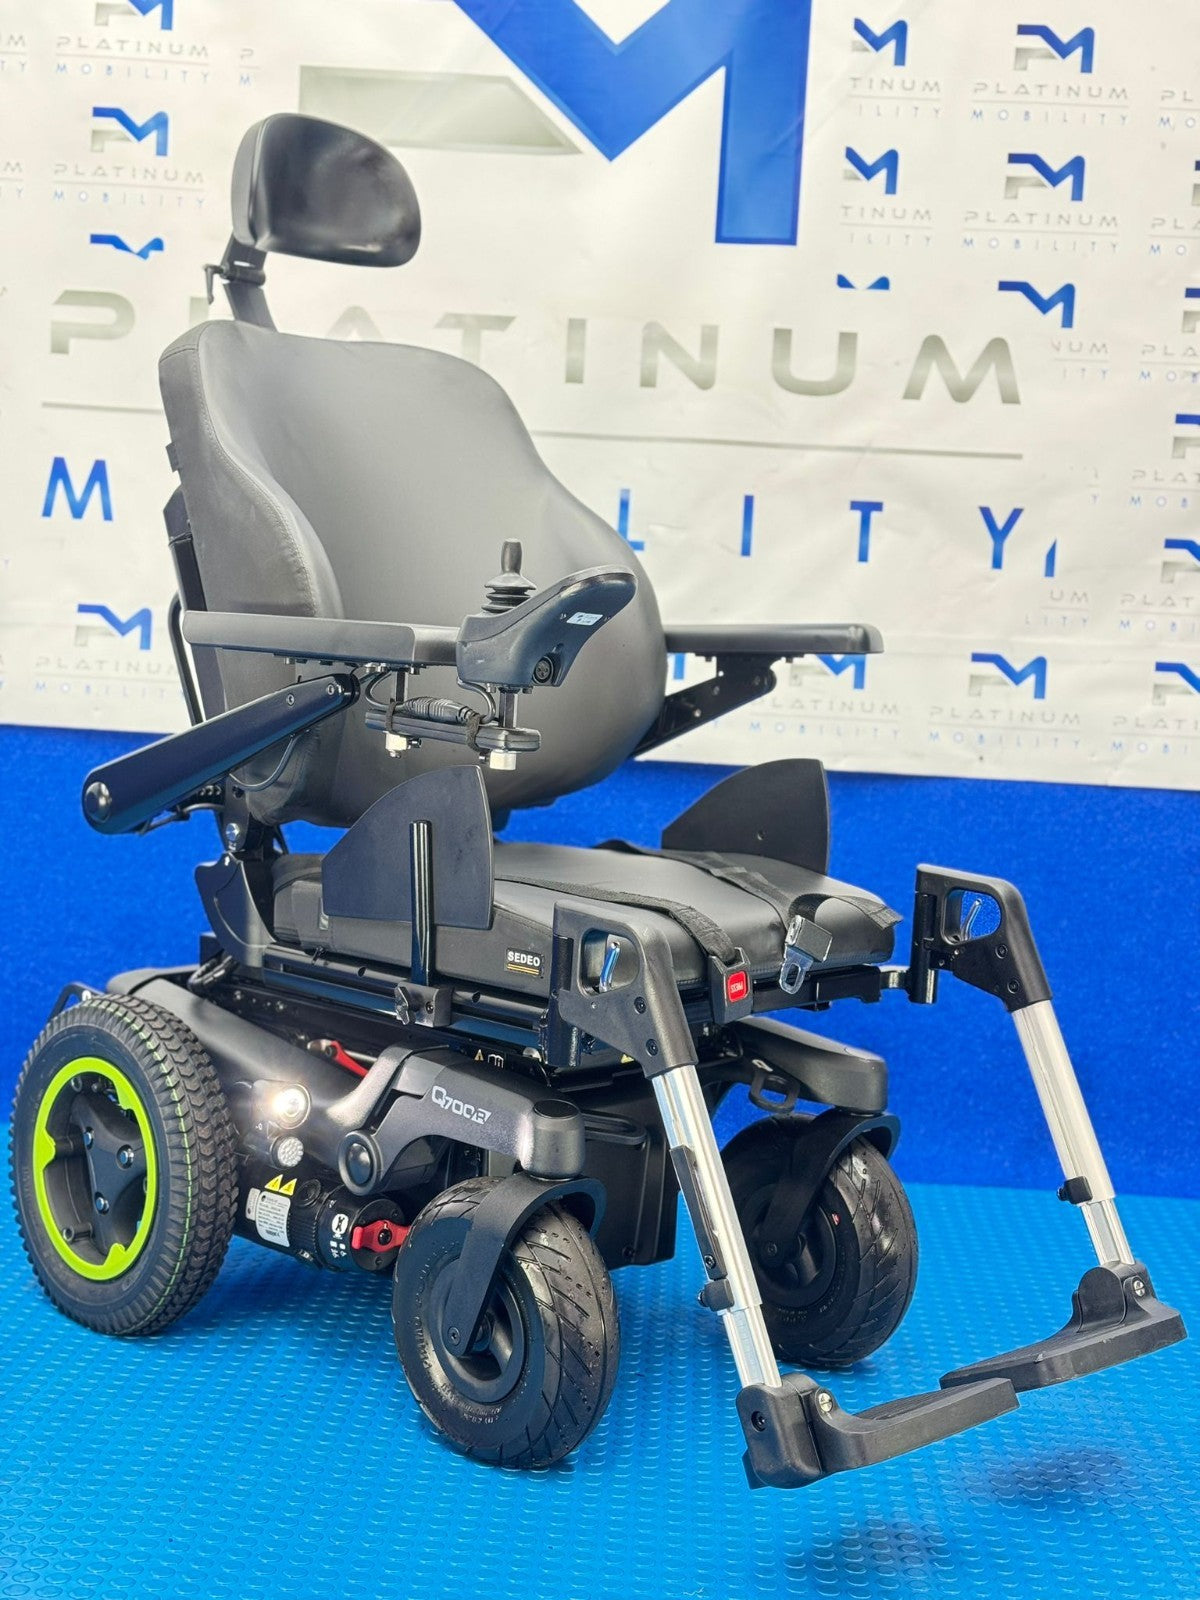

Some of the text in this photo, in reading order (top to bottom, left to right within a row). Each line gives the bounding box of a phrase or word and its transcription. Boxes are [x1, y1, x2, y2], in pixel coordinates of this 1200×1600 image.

[56, 36, 209, 58] PLATINUM
[56, 62, 210, 84] MOBILITY
[973, 82, 1129, 100] PLATINUM
[971, 109, 1128, 126] MOBILITY
[53, 163, 205, 183] PLATINUM
[53, 189, 205, 208] MOBILITY
[964, 210, 1118, 229] PLATINUM
[962, 238, 1118, 254] MOBILITY
[50, 289, 1021, 405] PTINUM
[35, 681, 184, 699] MOBILIT
[761, 696, 900, 715] LATINUM
[928, 705, 1081, 726] PLATINUM
[750, 721, 901, 738] MOBILITY
[928, 731, 1081, 749] MOBILITY
[507, 951, 541, 967] SEDEO
